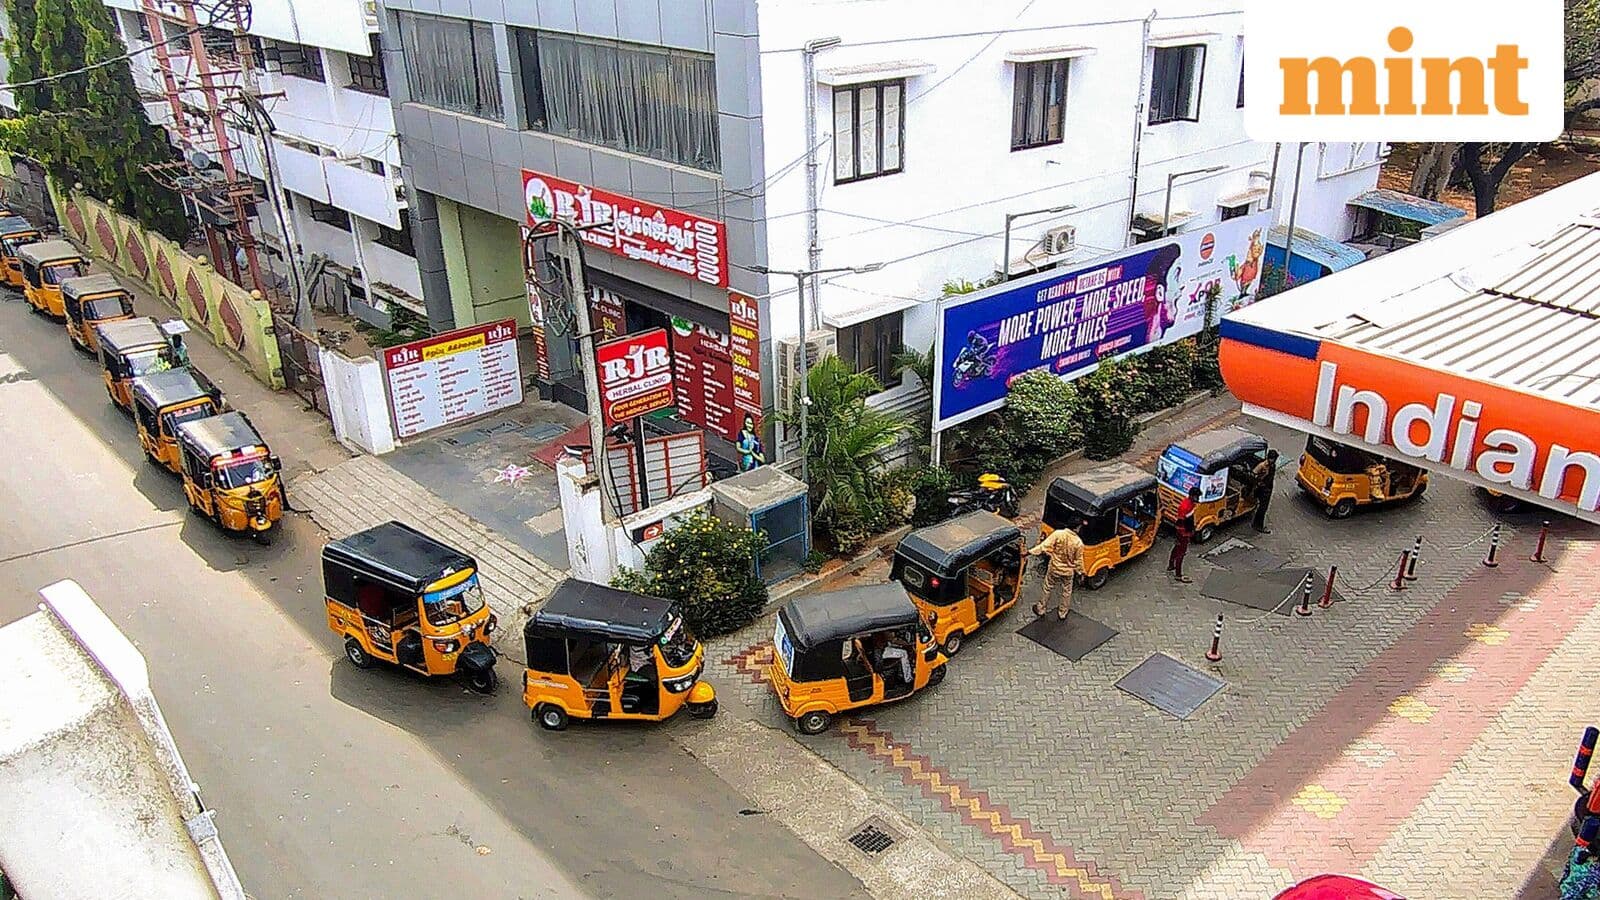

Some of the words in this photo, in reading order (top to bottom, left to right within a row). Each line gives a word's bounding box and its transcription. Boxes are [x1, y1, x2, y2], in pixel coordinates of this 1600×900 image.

[553, 187, 614, 230] RJR
[731, 300, 757, 320] RJR
[998, 311, 1034, 347] MORE
[1034, 298, 1077, 335] POWER,
[1081, 288, 1112, 319] MORE
[1113, 276, 1146, 308] SPEED,
[487, 325, 512, 340] RJR
[700, 339, 729, 355] HERBAL
[1041, 329, 1073, 360] MORE
[391, 348, 419, 364] RJR
[600, 345, 670, 383] RJR
[734, 364, 760, 380] DOCTORS
[612, 384, 643, 398] HERBAL
[643, 376, 667, 388] CLINIC
[1312, 361, 1600, 512] Indian
